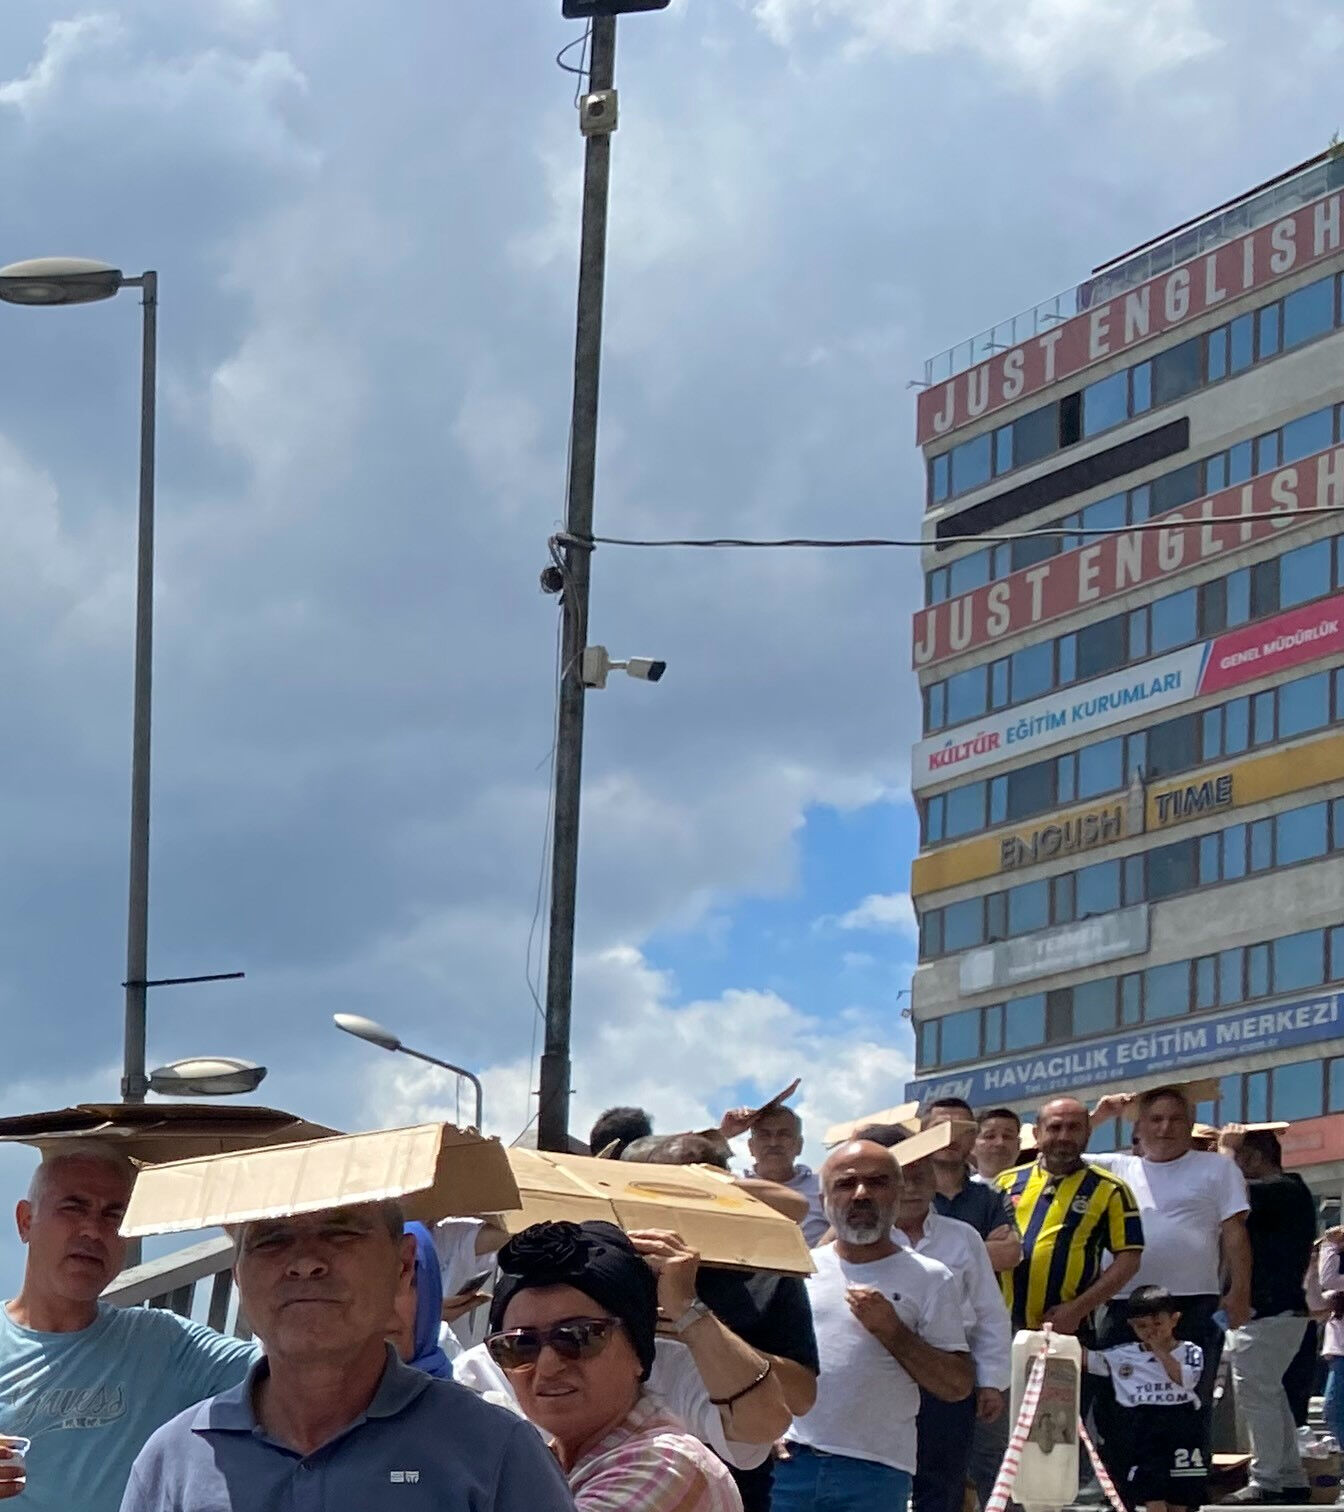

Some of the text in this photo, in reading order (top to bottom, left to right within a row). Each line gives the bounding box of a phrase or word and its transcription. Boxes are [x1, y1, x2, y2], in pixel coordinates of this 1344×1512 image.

[933, 194, 1340, 433] JUST ENGLISH
[914, 448, 1344, 664] JUST ENGLISH
[1220, 620, 1339, 669] GENEL MÜDÜRLÜK
[928, 669, 1182, 771] KÜLTÜR EĞİTİM KURUMLARI
[1000, 774, 1234, 871] ENGLISH TIME
[984, 1048, 1109, 1091] HAVACILIK
[1116, 1027, 1208, 1065] EĞİTİM
[1216, 995, 1339, 1045] MERKEZİ
[1174, 1447, 1204, 1468] 24
